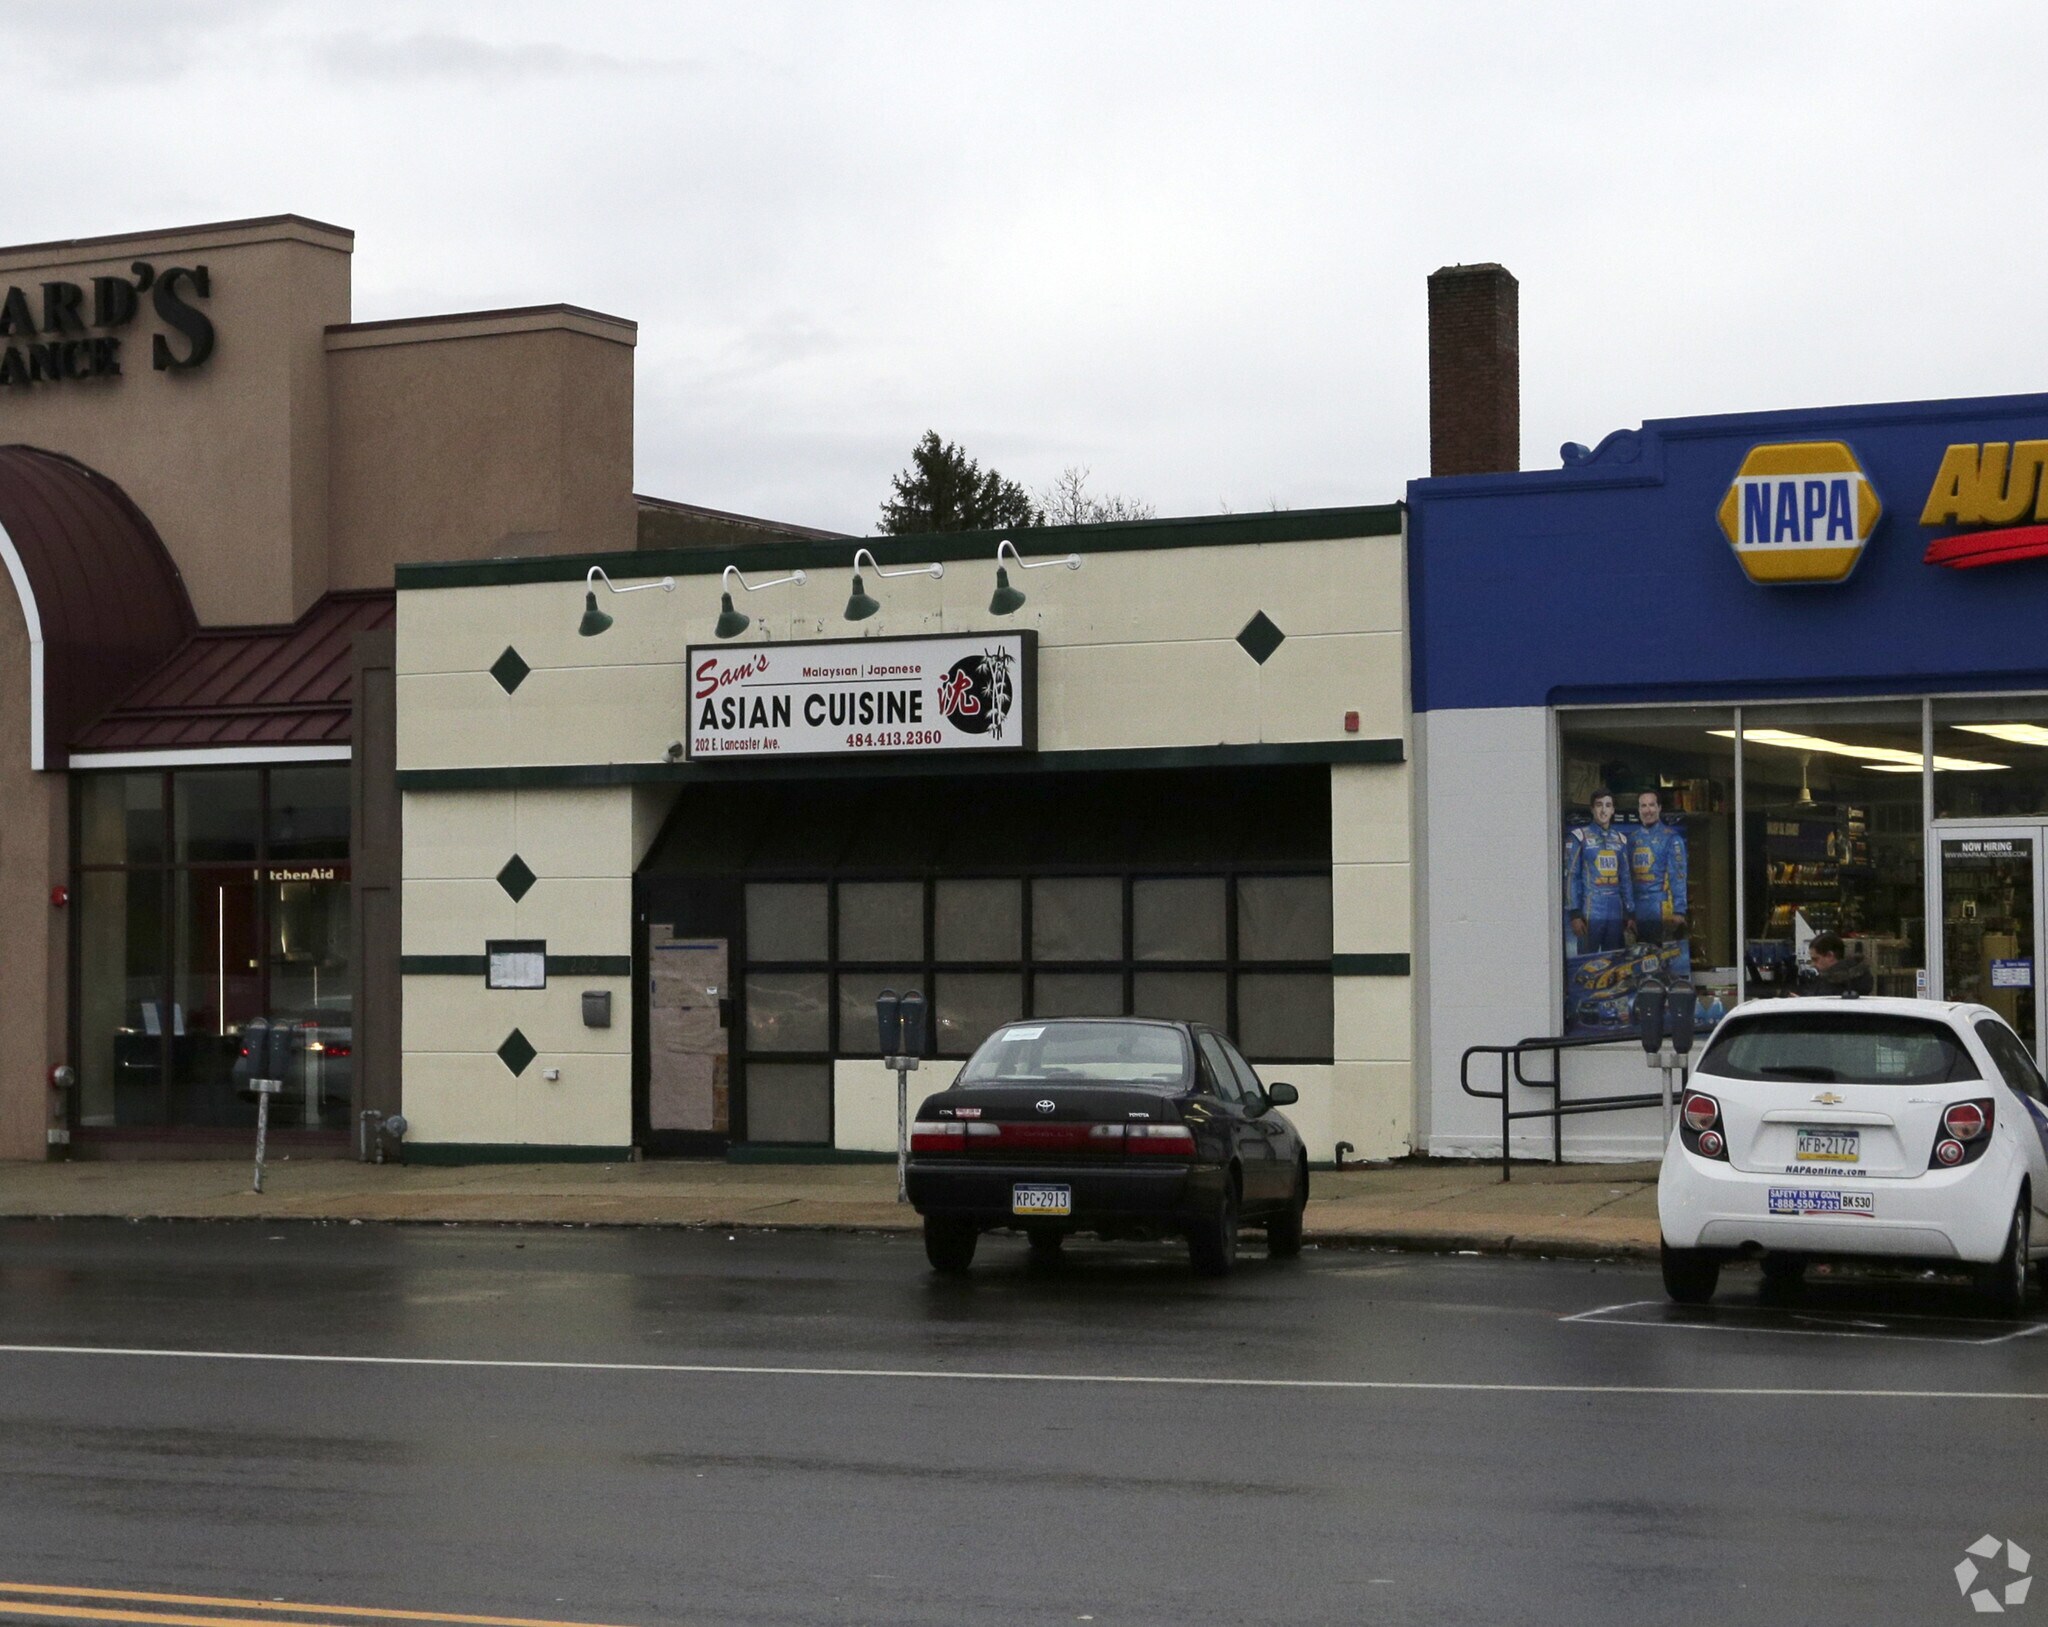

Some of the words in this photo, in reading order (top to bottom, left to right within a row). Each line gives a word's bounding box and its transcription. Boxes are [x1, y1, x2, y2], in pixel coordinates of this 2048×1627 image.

[1743, 478, 1854, 545] NAPA
[695, 653, 770, 700] Sam's
[802, 664, 858, 679] Malaysian
[867, 664, 922, 677] Japanese
[699, 695, 791, 730] ASIAN
[803, 690, 923, 728] CUISINE
[695, 738, 710, 752] 202
[720, 737, 761, 751] Lancaster
[763, 736, 780, 750] Ave.
[846, 730, 942, 748] 484.413.2360
[1962, 842, 1981, 851] NOW
[1983, 842, 2012, 851] HIRING
[253, 867, 335, 881] tchenAid
[1785, 1165, 1867, 1176] NAPAonline.com
[1769, 1189, 1797, 1198] SAFETY
[1799, 1190, 1807, 1198] IS
[1808, 1191, 1819, 1199] MY
[1820, 1191, 1840, 1200] GOAL
[1769, 1198, 1840, 1210] 1-888-550-7233
